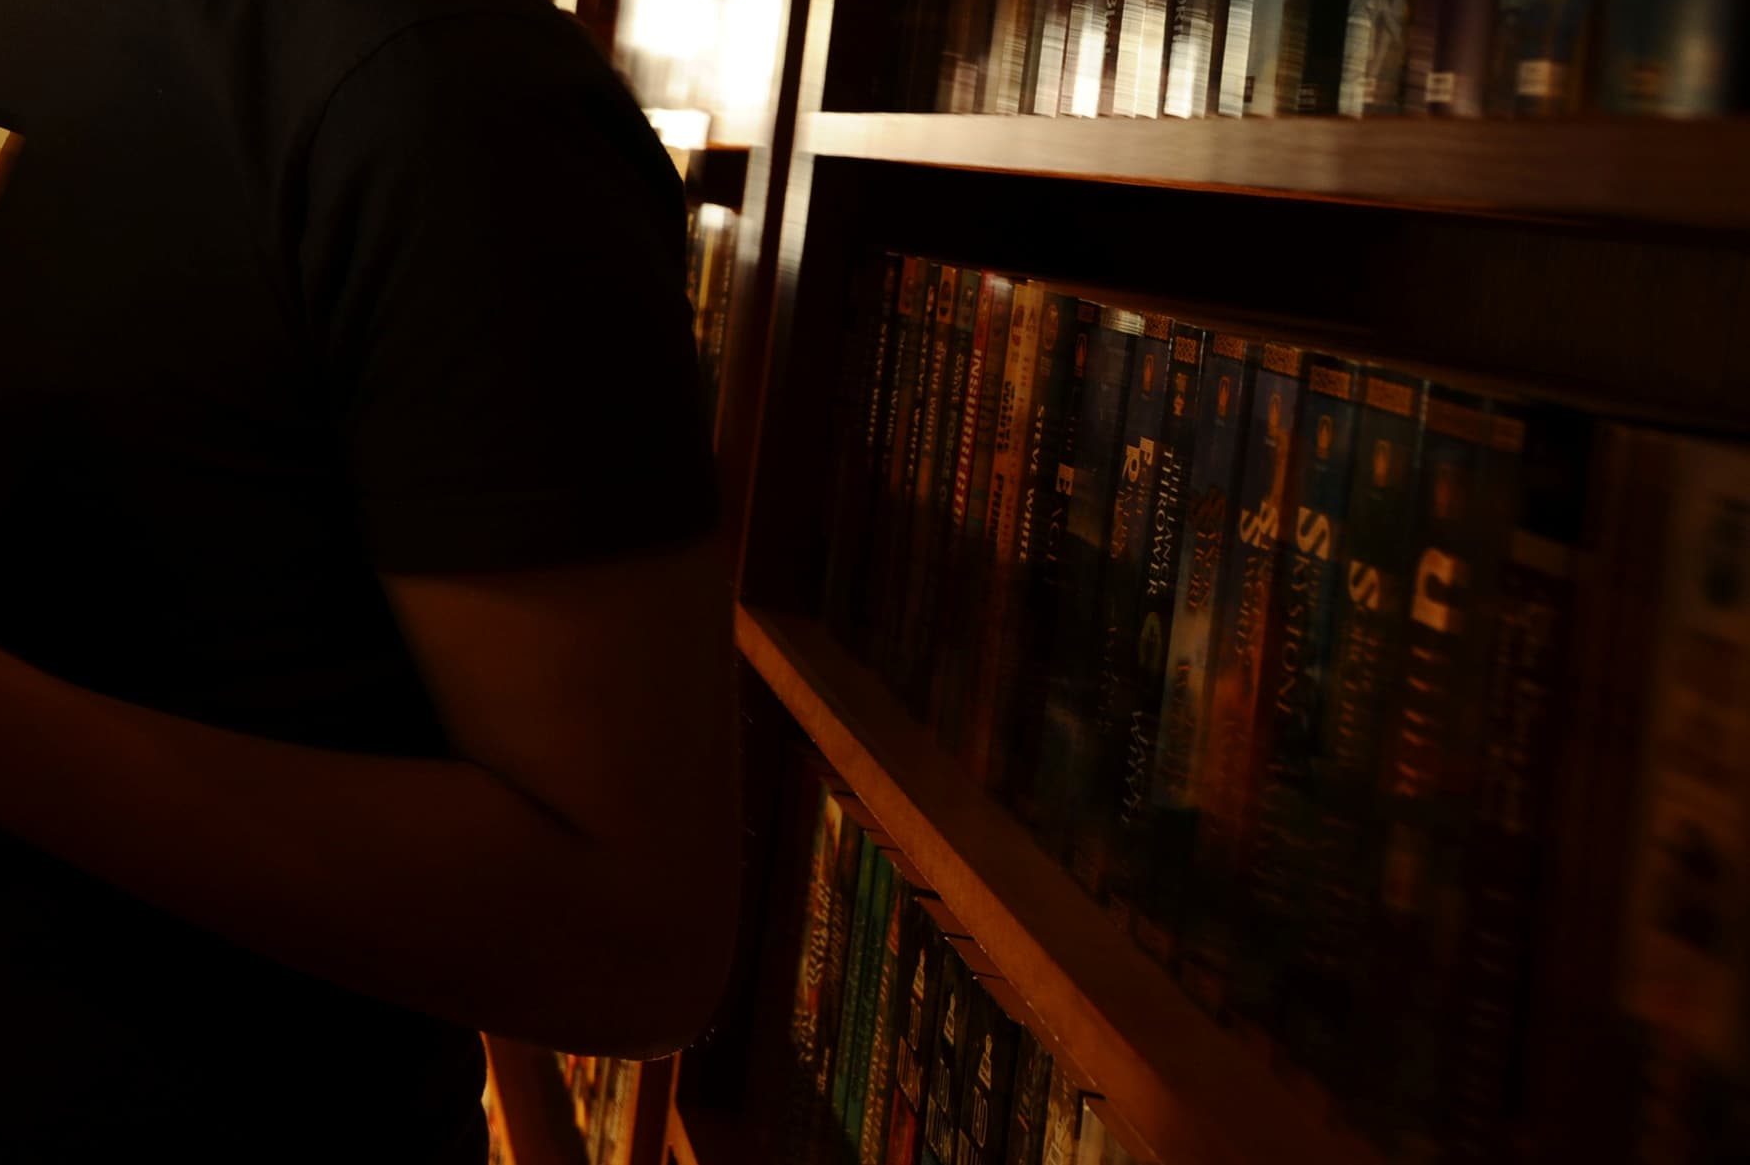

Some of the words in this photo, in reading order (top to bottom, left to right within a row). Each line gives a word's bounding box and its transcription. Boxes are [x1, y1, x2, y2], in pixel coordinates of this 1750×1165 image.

[1029, 403, 1047, 477] STEVE
[1018, 486, 1036, 565] WHITE
[1146, 449, 1174, 598] THROWER
